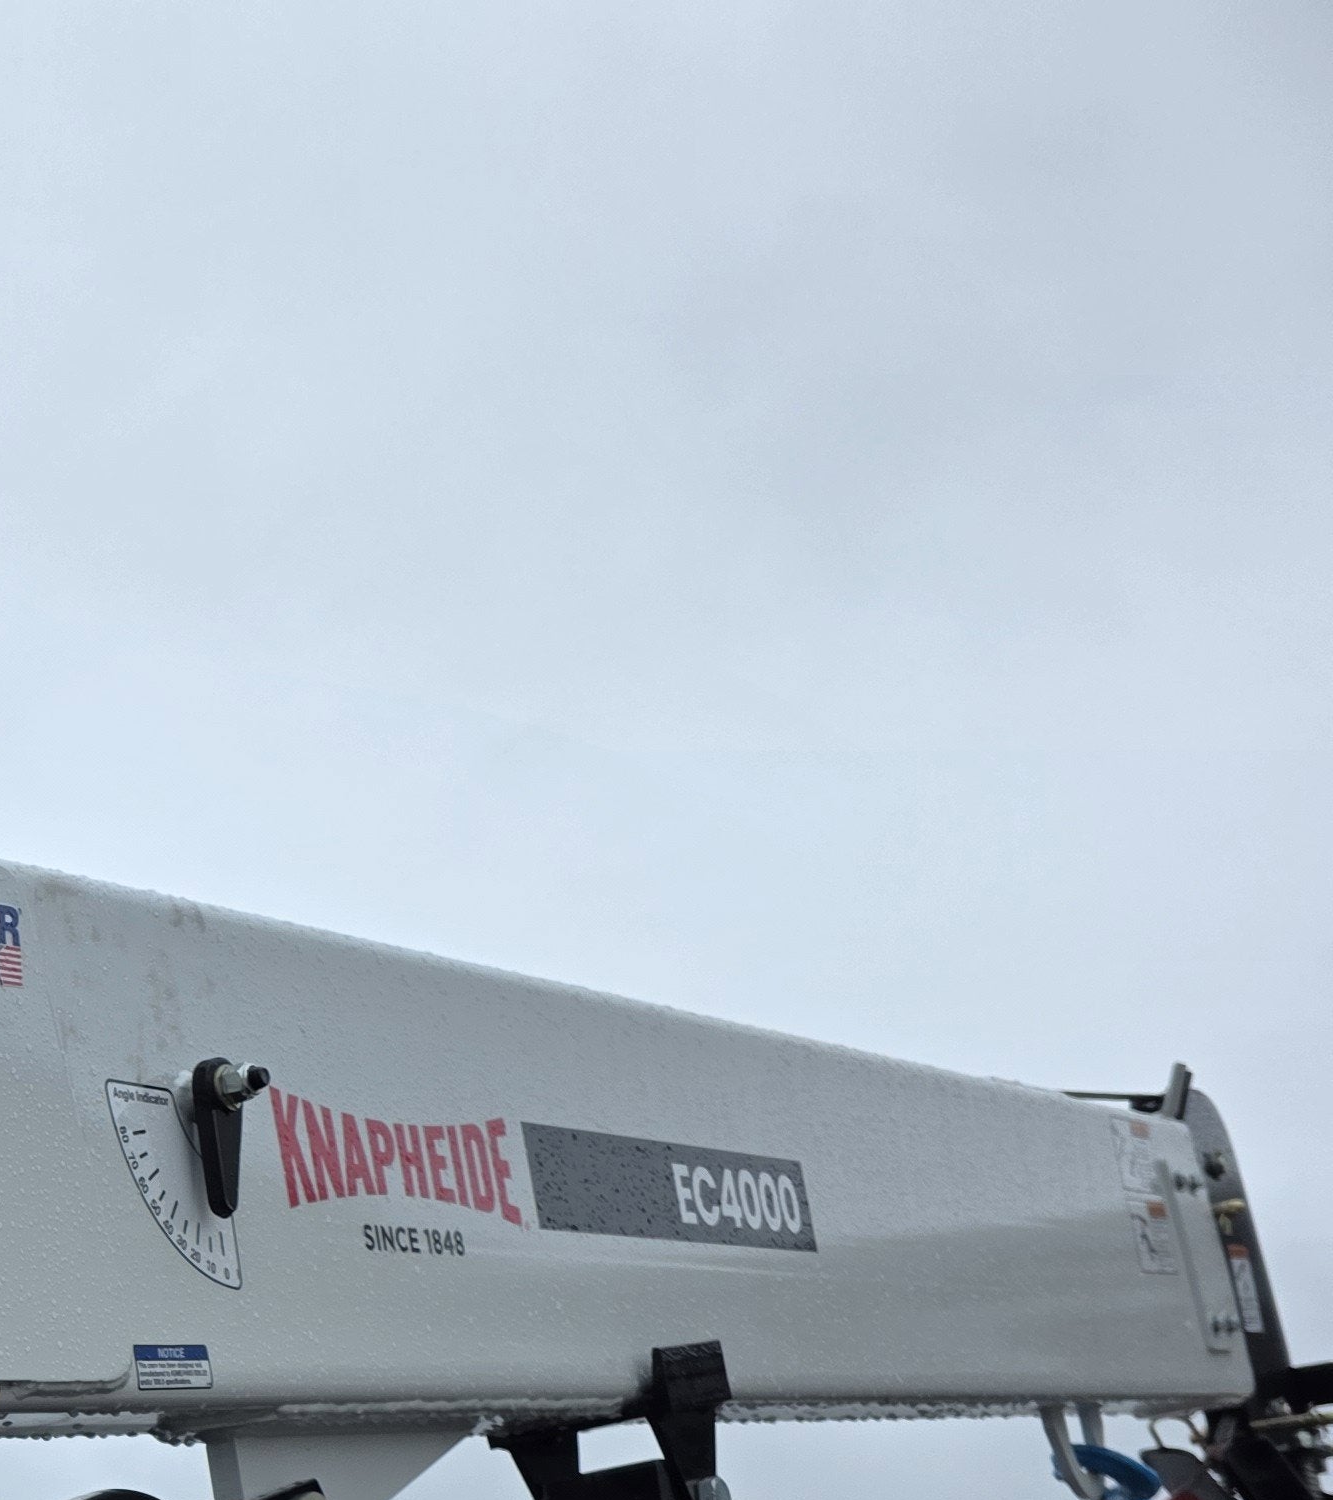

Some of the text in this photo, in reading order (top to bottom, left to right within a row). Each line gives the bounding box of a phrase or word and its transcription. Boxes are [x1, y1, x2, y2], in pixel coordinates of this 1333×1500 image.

[113, 1087, 169, 1106] Angle Indicator
[127, 1152, 138, 1170] 70
[269, 1085, 523, 1227] KNAPHEIDE
[138, 1176, 149, 1194] 60
[671, 1162, 801, 1234] EC4000
[150, 1199, 162, 1216] 50
[363, 1224, 465, 1256] SINCE 1848
[190, 1248, 201, 1263] 20
[206, 1260, 216, 1274] 10
[157, 1347, 186, 1358] NOTICE
